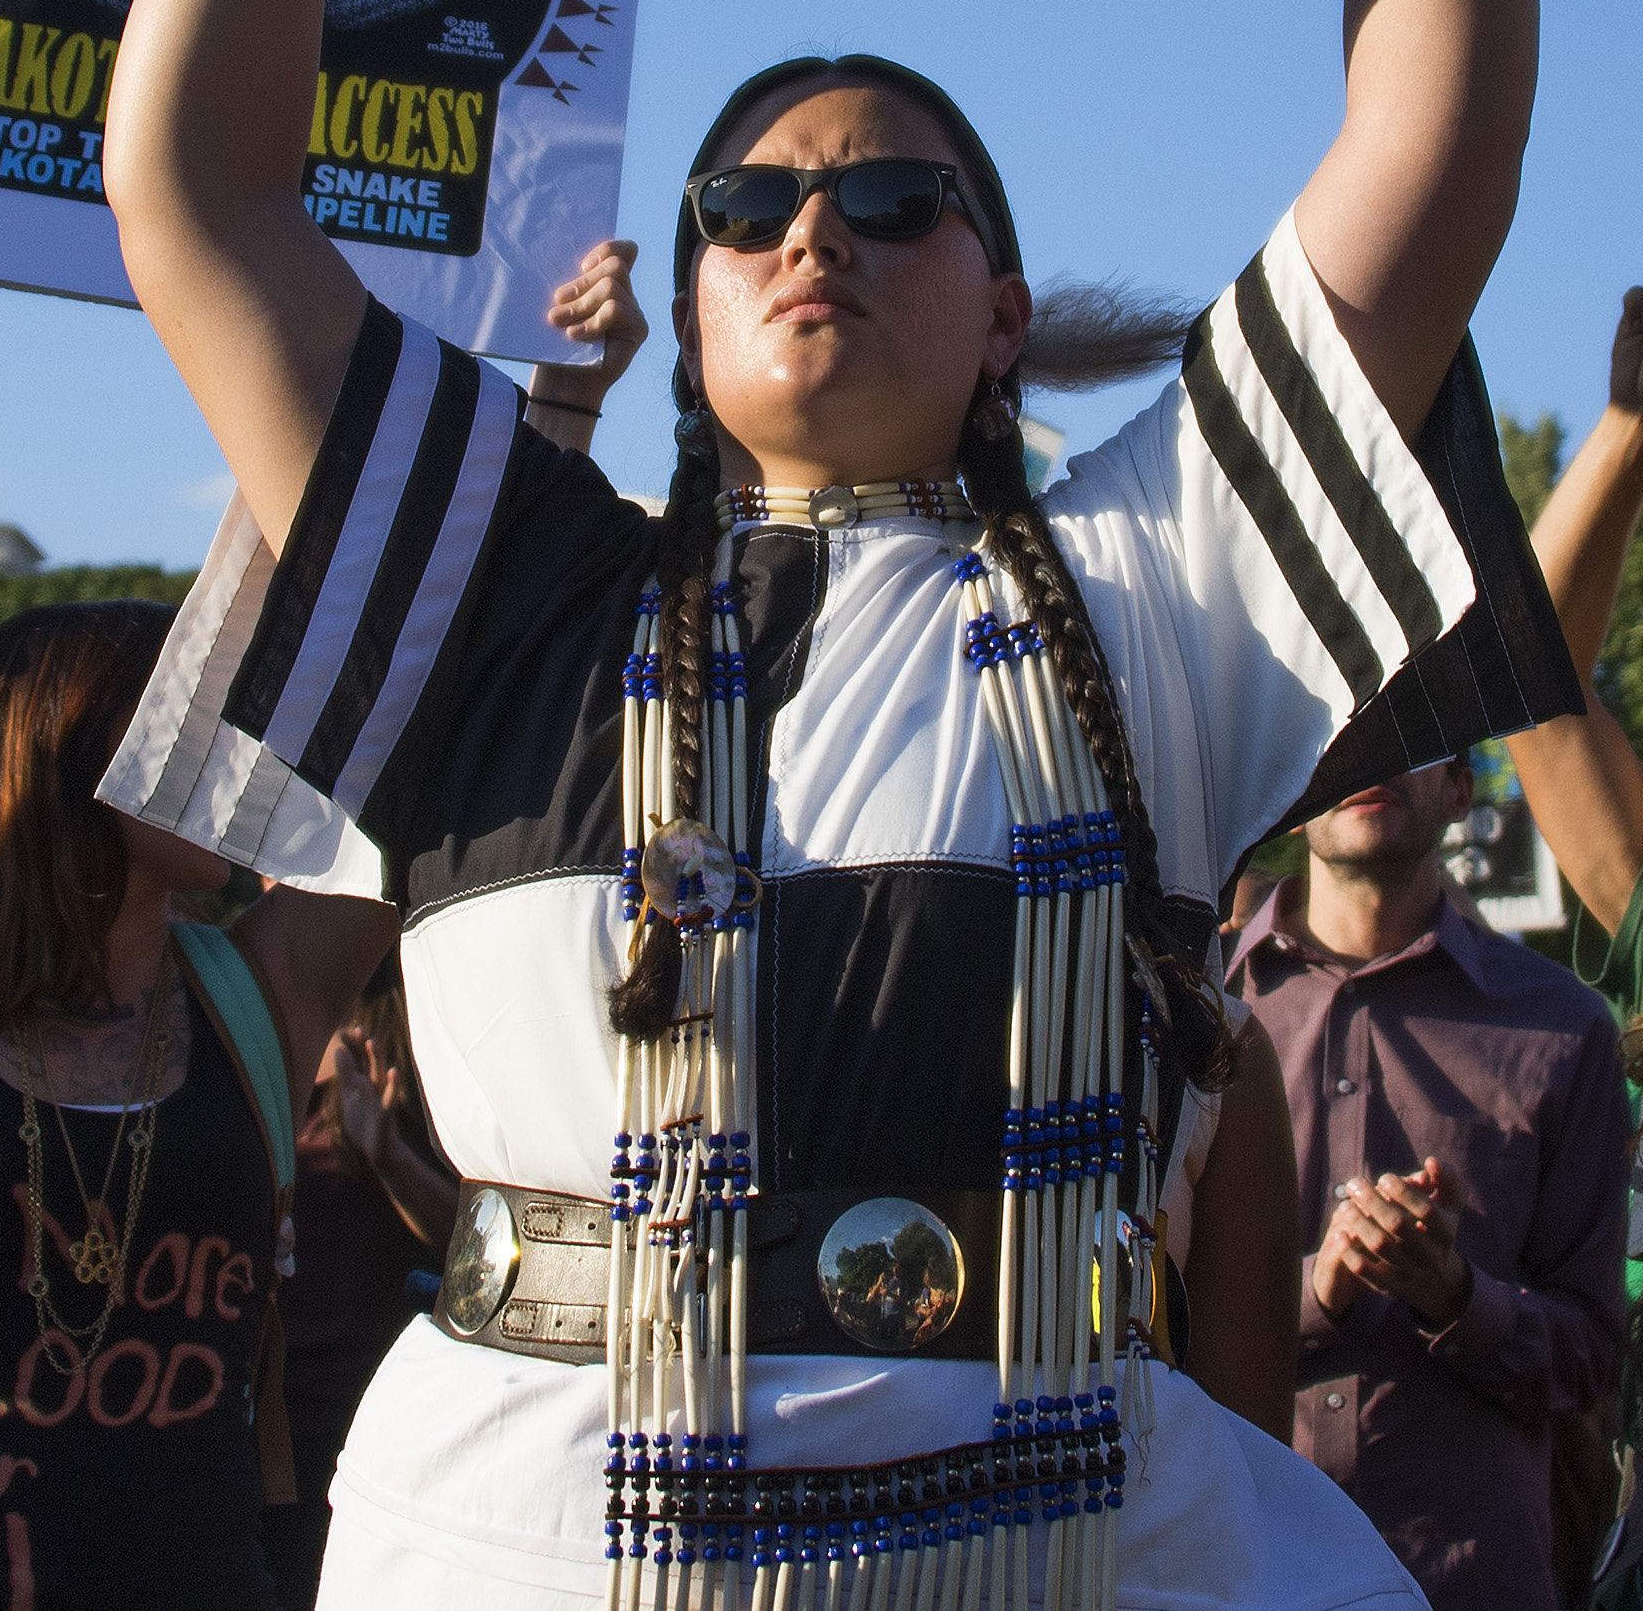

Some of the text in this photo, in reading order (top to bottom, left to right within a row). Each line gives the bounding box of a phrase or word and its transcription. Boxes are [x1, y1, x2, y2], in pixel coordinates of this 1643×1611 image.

[427, 42, 505, 61] m2bulls.com
[312, 164, 442, 209] SNAKE
[304, 194, 451, 241] IPELINE
